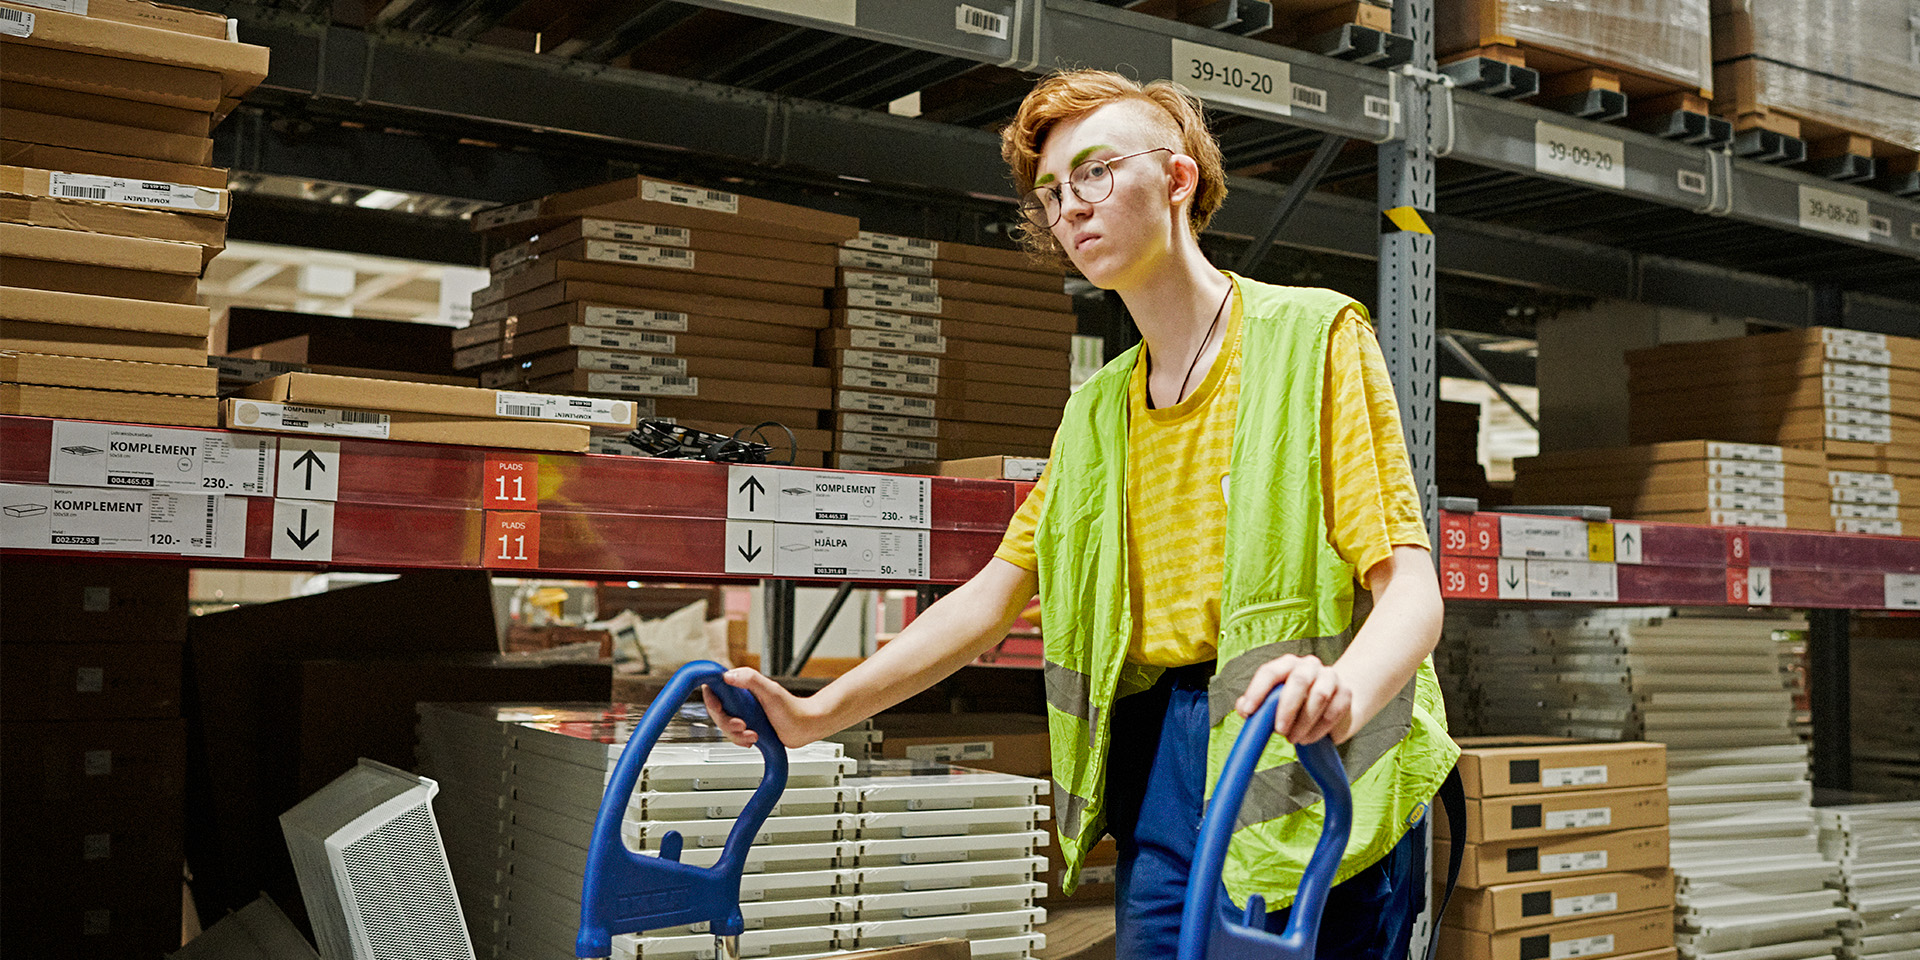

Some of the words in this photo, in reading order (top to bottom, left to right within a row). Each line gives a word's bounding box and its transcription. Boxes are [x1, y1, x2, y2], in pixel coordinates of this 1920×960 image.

[1191, 59, 1273, 94] 39-10-20
[1548, 140, 1613, 171] 39-09-20
[123, 195, 170, 204] KOMPLEMENT
[1808, 198, 1859, 225] 39-08-20
[283, 406, 326, 415] KOMPLEMENT
[554, 412, 592, 420] KOMPLEMENT
[110, 441, 197, 456] KOMPLEMENT
[499, 463, 523, 471] PLADS
[111, 477, 151, 486] 004.465.05
[203, 477, 233, 489] 230.-
[495, 475, 526, 501] 11
[815, 483, 876, 495] KOMPLEMENT
[54, 500, 143, 513] KOMPLEMENT
[881, 511, 903, 521] 230.-
[502, 521, 526, 530] PLADS
[56, 536, 96, 544] 002.572.98
[150, 533, 180, 545] 120.-
[814, 536, 848, 547] HJÄLPA
[1446, 529, 1466, 550] 39
[1479, 530, 1490, 550] 9
[498, 534, 528, 560] 11
[1733, 537, 1744, 558] 8
[881, 565, 897, 575] 50.-
[1446, 571, 1466, 592] 39
[1478, 572, 1489, 593] 9
[1733, 580, 1743, 600] 8
